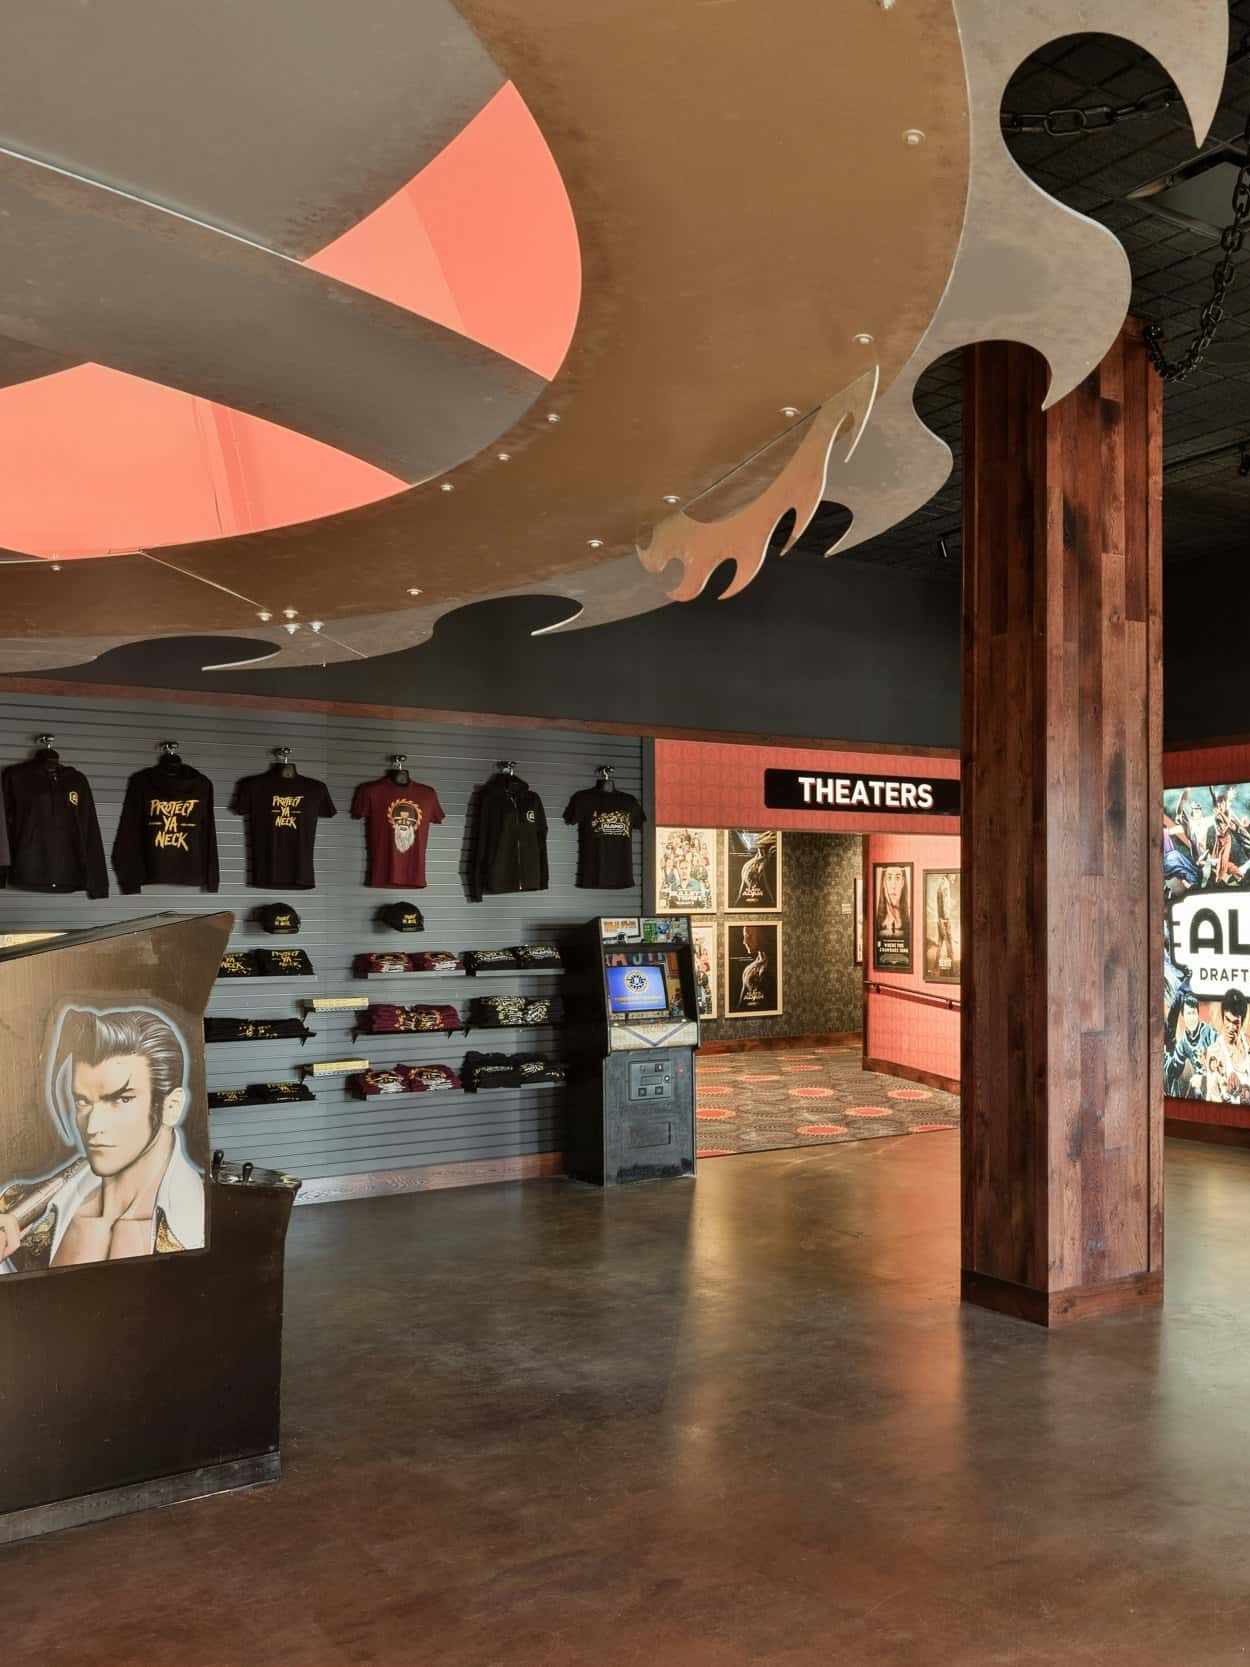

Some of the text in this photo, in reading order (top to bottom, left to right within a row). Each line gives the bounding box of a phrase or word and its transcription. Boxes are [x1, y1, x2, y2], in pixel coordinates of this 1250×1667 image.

[272, 795, 304, 807] PROTECT
[798, 776, 934, 808] THEATERS
[150, 799, 200, 817] PROTECT
[281, 806, 290, 817] YA
[162, 815, 178, 833] YA
[275, 816, 297, 829] NECK
[155, 831, 189, 851] NECK
